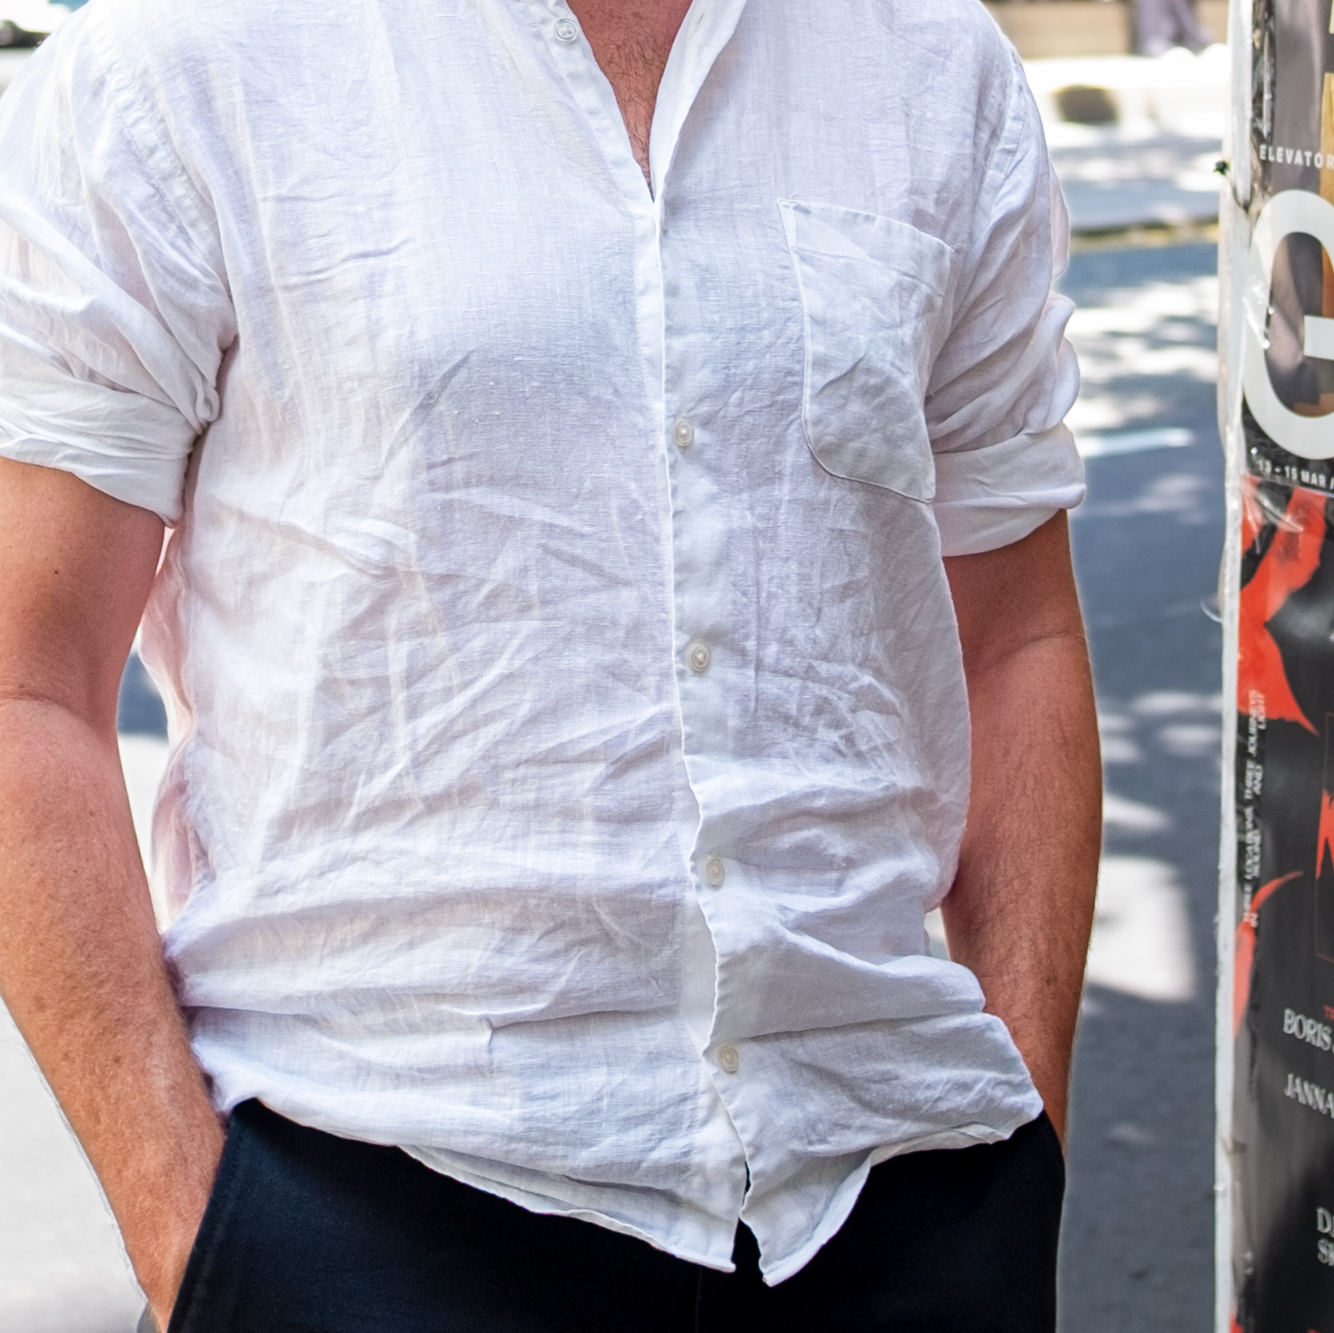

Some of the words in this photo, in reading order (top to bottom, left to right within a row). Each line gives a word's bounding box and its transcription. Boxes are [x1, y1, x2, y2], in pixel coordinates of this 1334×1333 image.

[1259, 144, 1334, 170] ELEVATOR
[1301, 469, 1327, 489] MAR
[1283, 1008, 1332, 1051] BORIS
